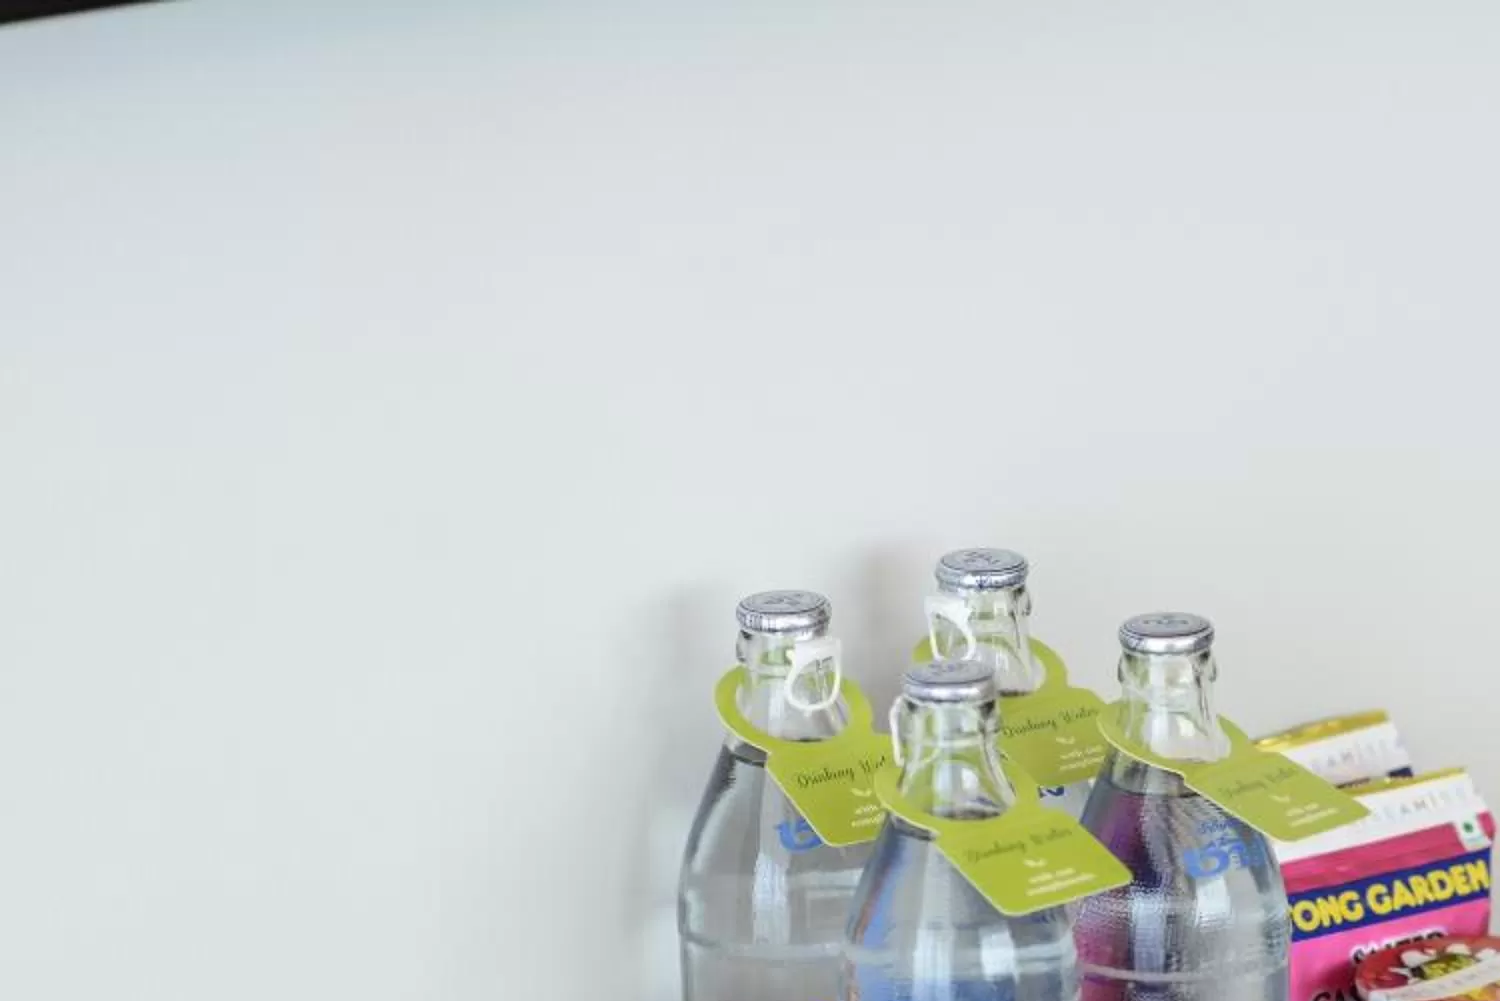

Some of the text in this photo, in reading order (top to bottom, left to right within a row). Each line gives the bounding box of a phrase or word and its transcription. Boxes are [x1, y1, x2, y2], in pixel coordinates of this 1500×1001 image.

[793, 765, 856, 789] Drinking
[1288, 859, 1493, 932] ONG GARDEN
